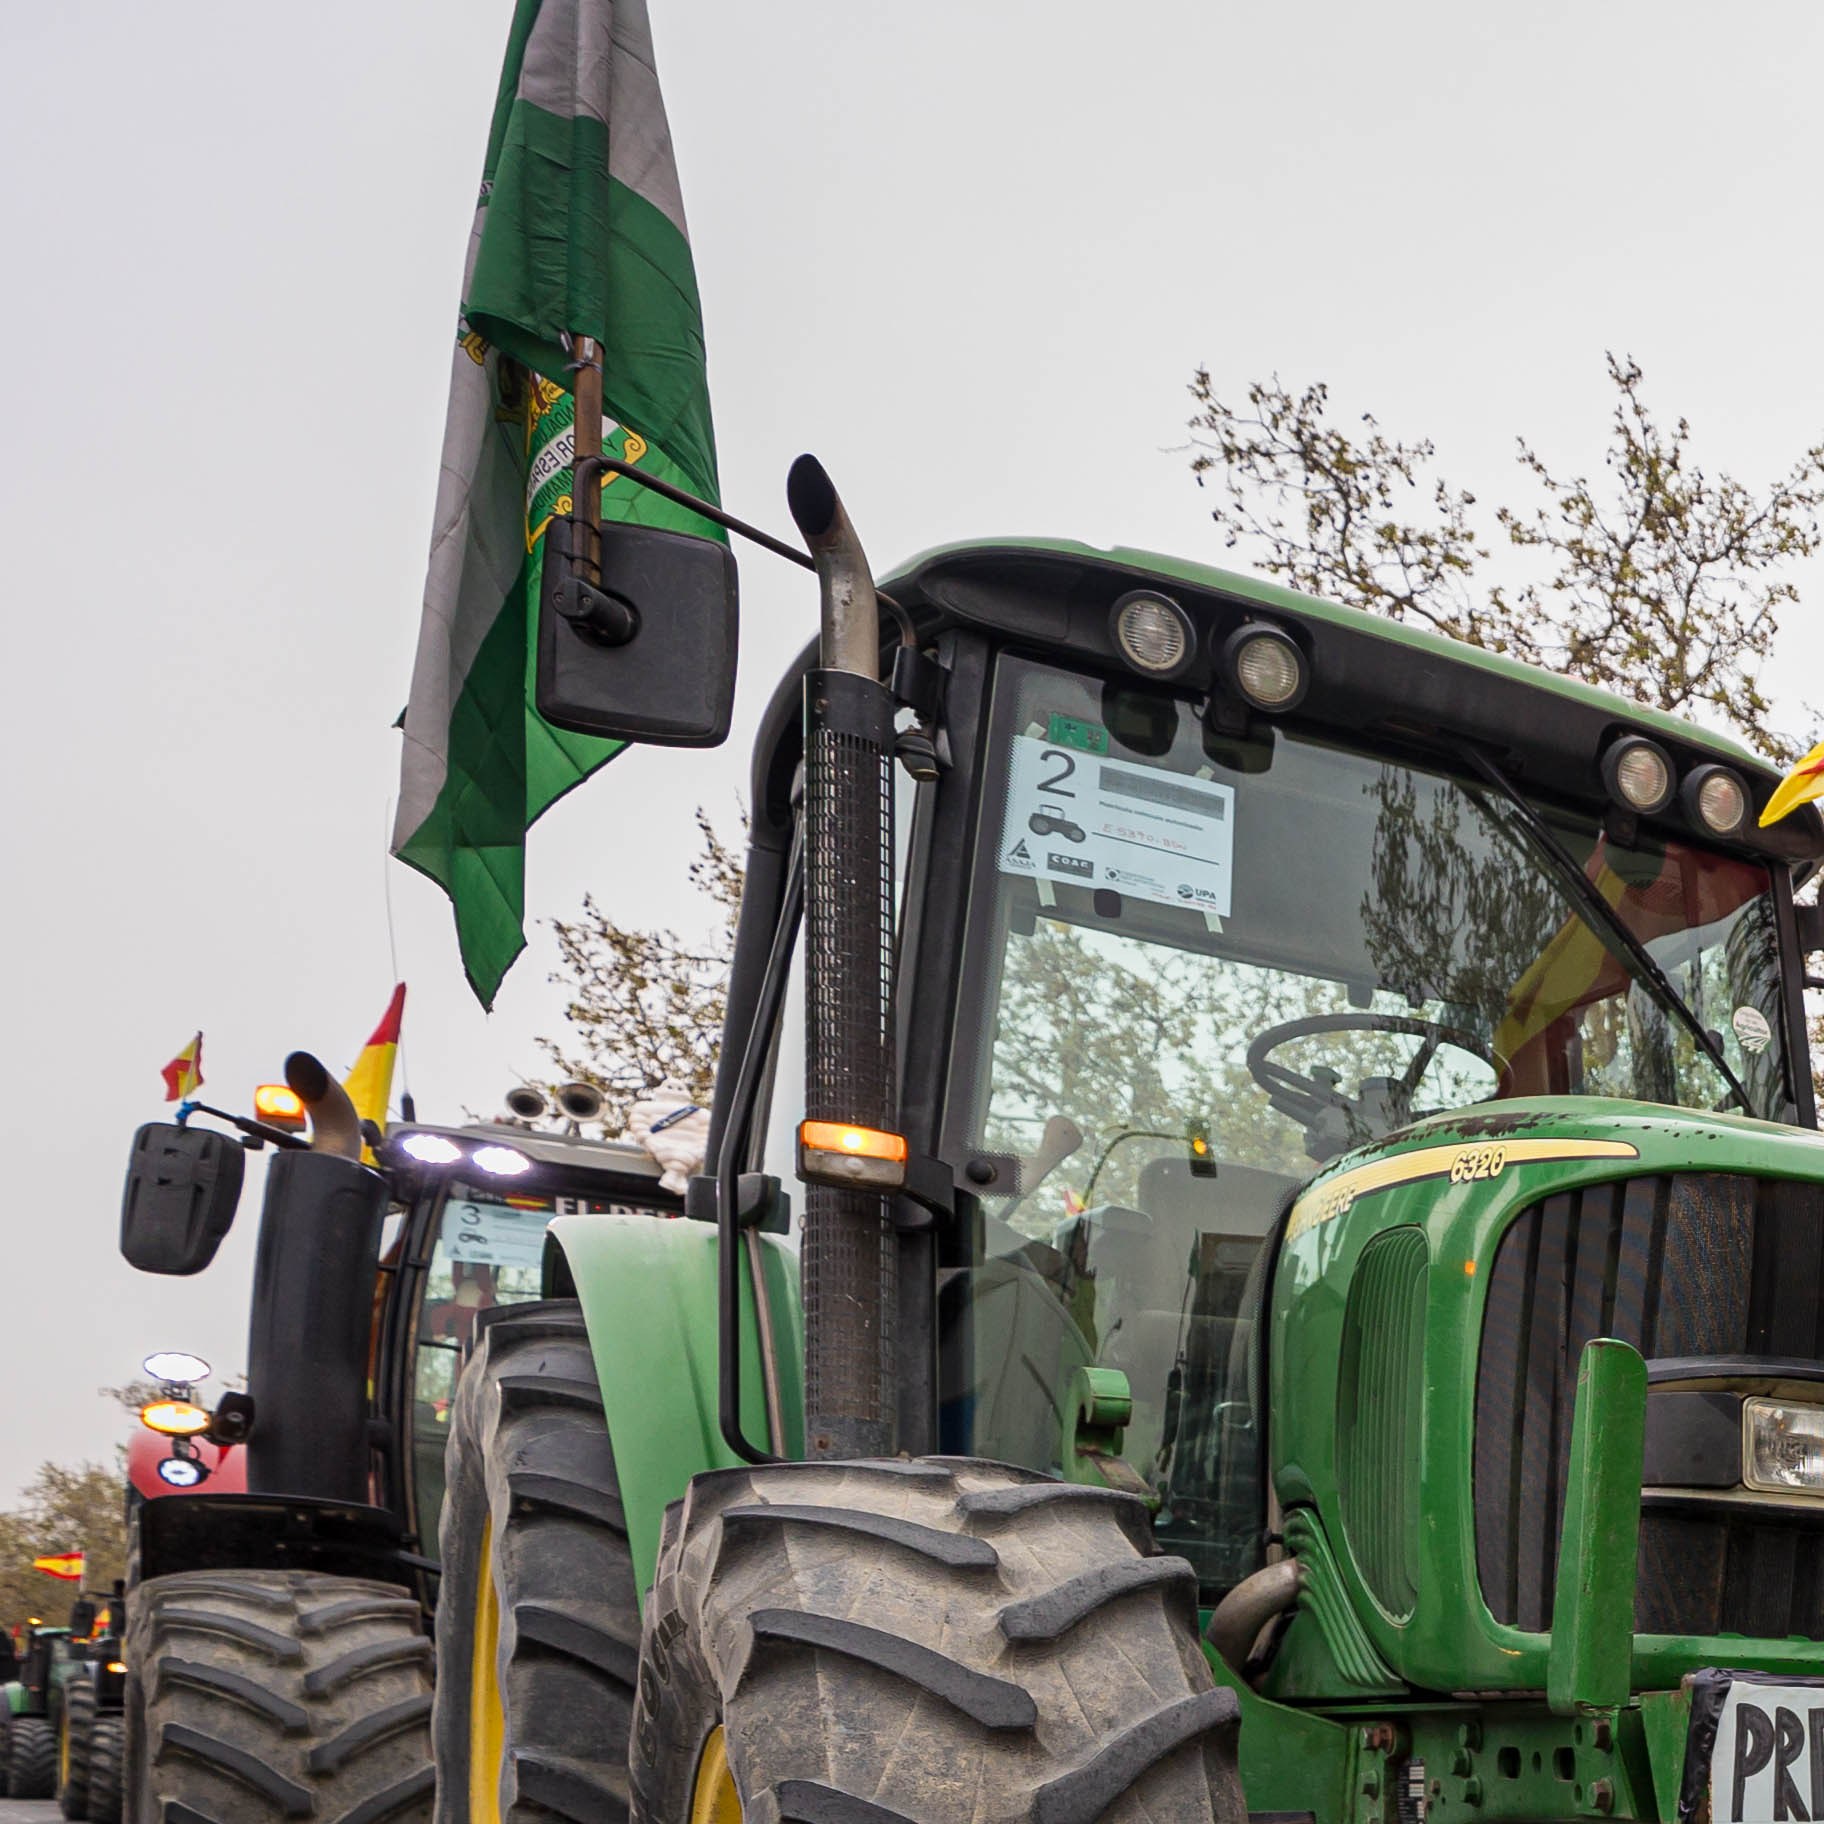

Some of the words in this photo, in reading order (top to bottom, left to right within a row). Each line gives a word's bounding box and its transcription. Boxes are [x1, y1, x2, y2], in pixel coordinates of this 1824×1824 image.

[1036, 750, 1076, 799] 2
[1195, 888, 1216, 900] UPA
[1450, 1146, 1507, 1185] 6320
[461, 1205, 481, 1226] 3
